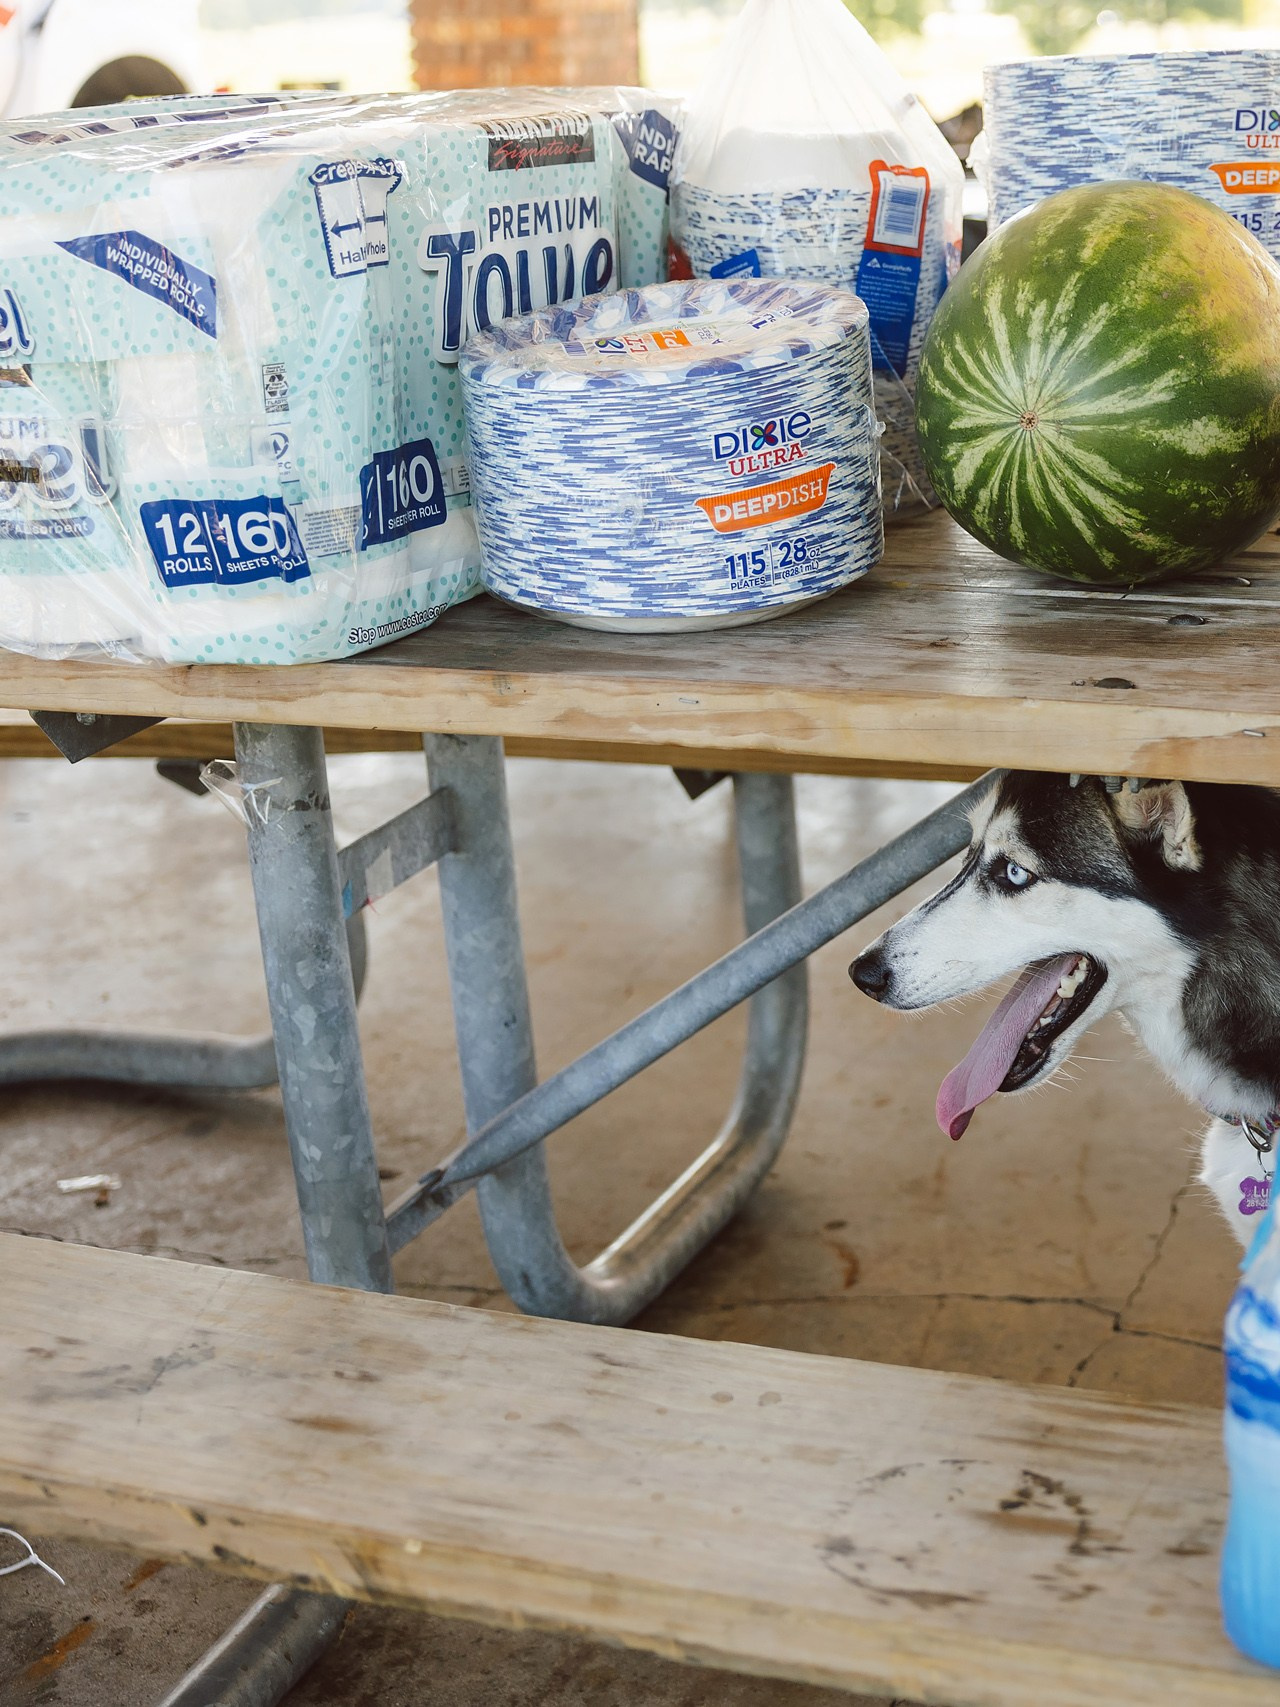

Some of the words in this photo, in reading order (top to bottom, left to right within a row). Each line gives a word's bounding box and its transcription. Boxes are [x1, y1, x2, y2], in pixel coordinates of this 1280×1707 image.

[493, 141, 592, 172] Signature
[488, 195, 599, 243] PREMIUM
[106, 246, 168, 290] WRAPPED
[119, 238, 202, 297] INDIVIDUALLY
[170, 284, 206, 317] ROLLS
[728, 443, 804, 476] ULTRA
[419, 503, 441, 517] ROLL
[154, 512, 208, 556] 12
[218, 511, 291, 559] 160
[163, 556, 213, 575] ROLLS
[227, 555, 270, 573] SHEETS
[281, 555, 307, 572] OLL
[725, 550, 766, 580] 115
[778, 537, 807, 568] 28
[730, 576, 766, 591] PLATES
[1253, 1185, 1269, 1198] Lu
